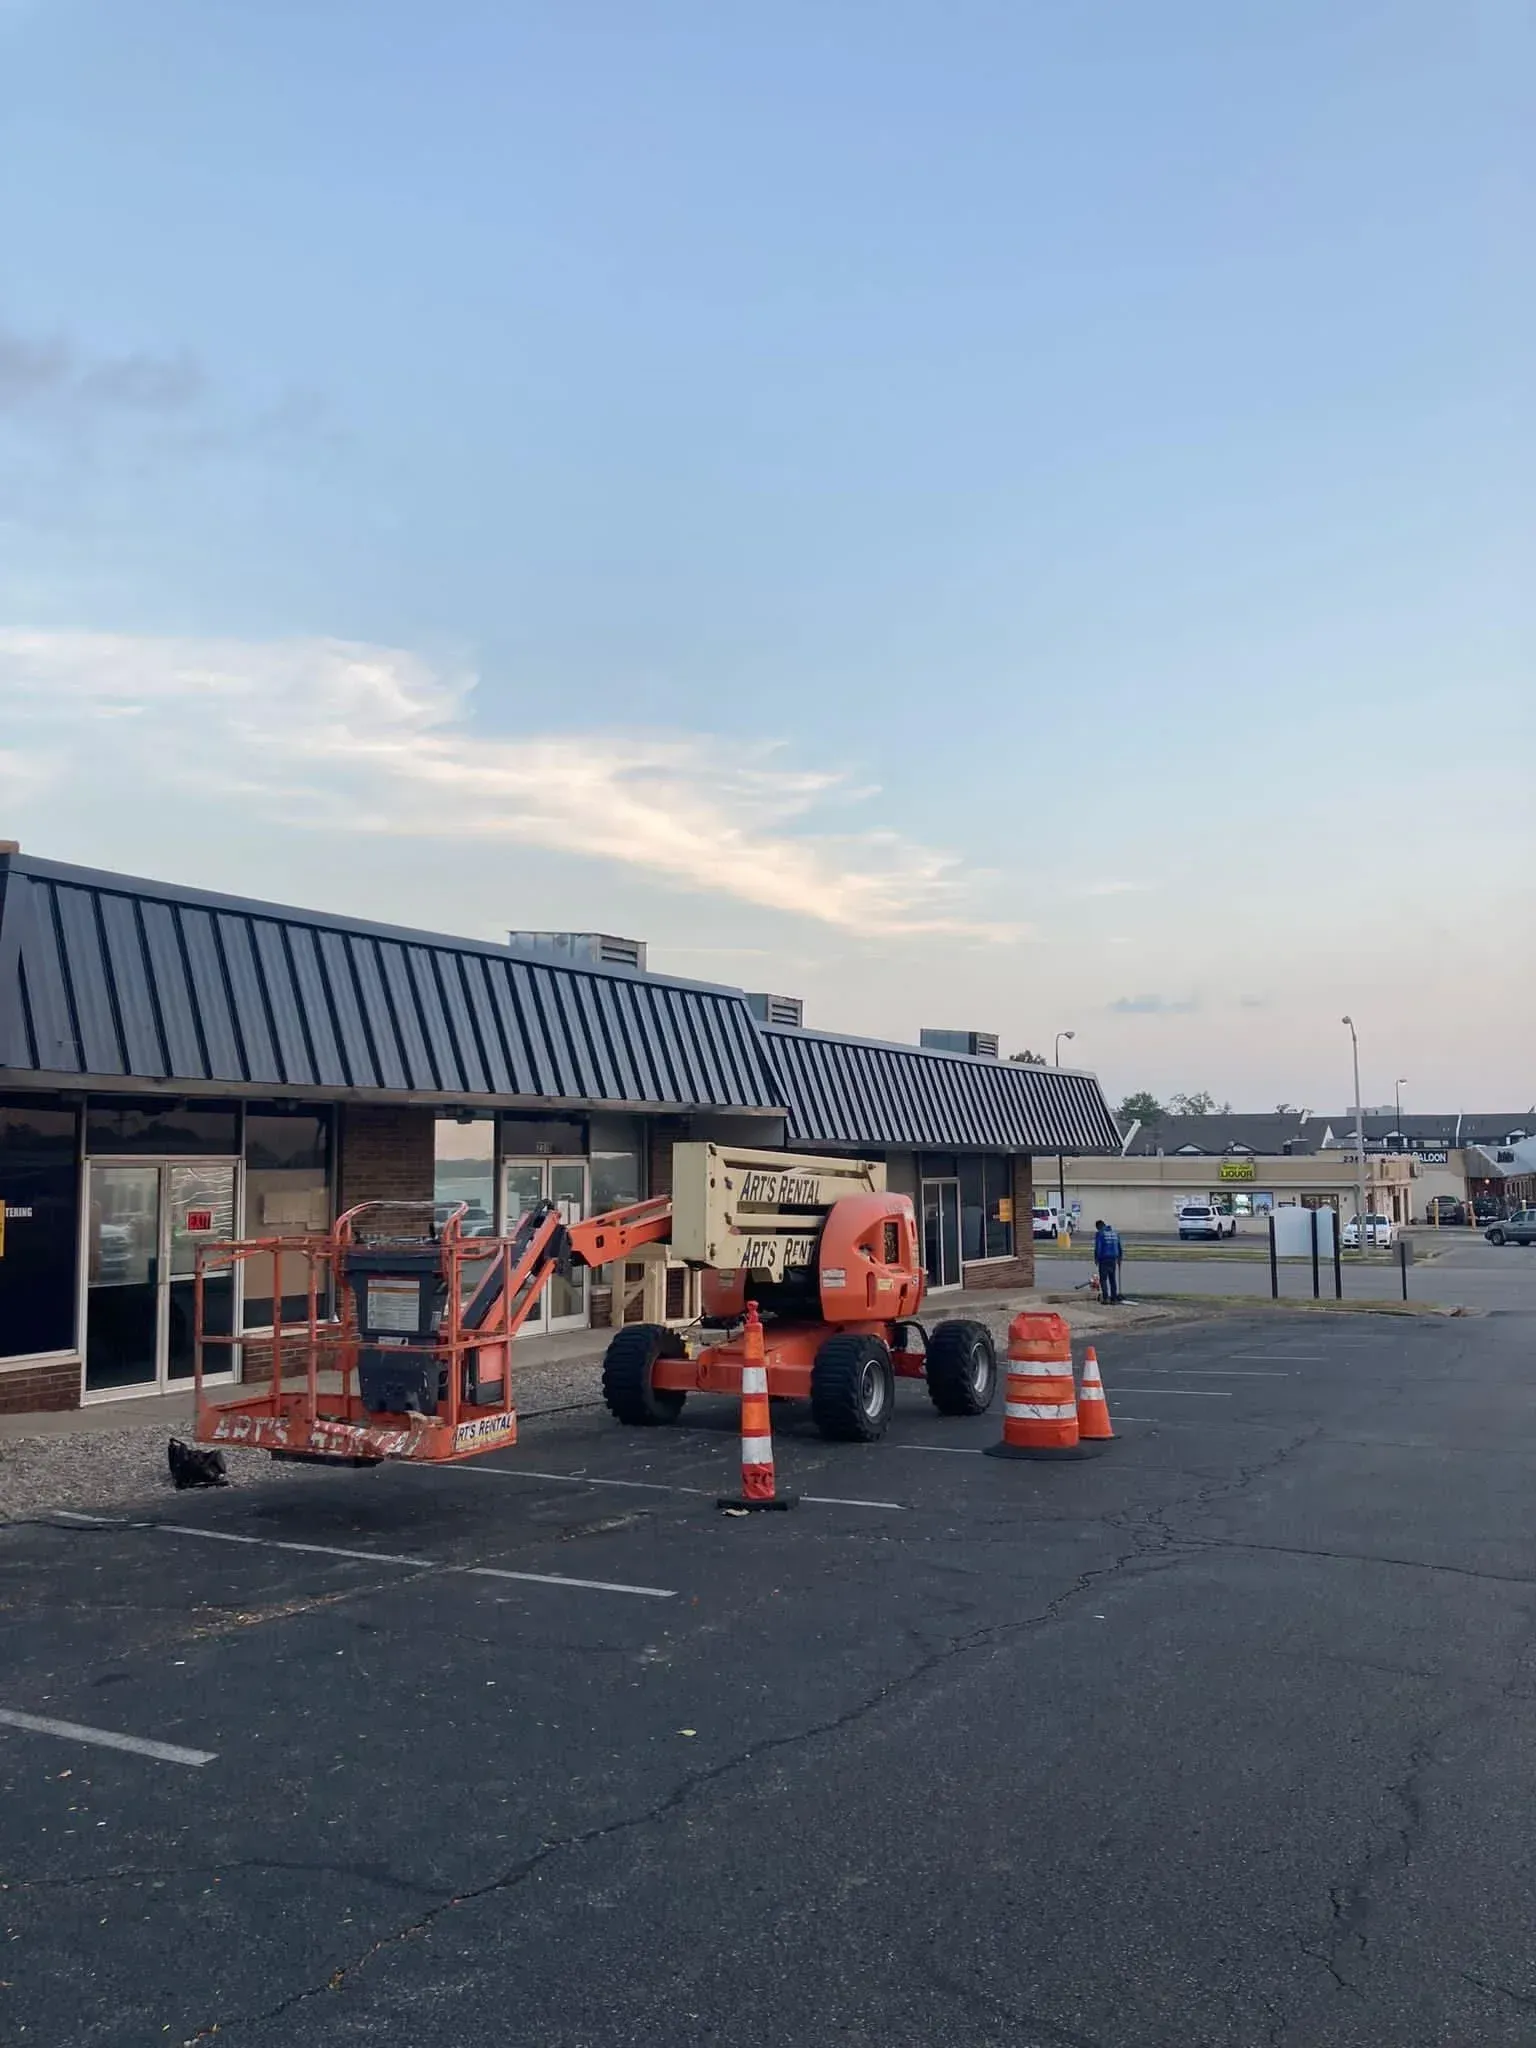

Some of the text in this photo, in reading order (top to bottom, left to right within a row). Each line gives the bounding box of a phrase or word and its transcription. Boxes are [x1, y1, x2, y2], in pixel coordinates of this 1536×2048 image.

[1221, 1170, 1253, 1178] LIQUOR
[740, 1172, 820, 1204] ART'S RENTAL
[741, 1237, 777, 1267] ART'S
[479, 1415, 511, 1435] RENTAL
